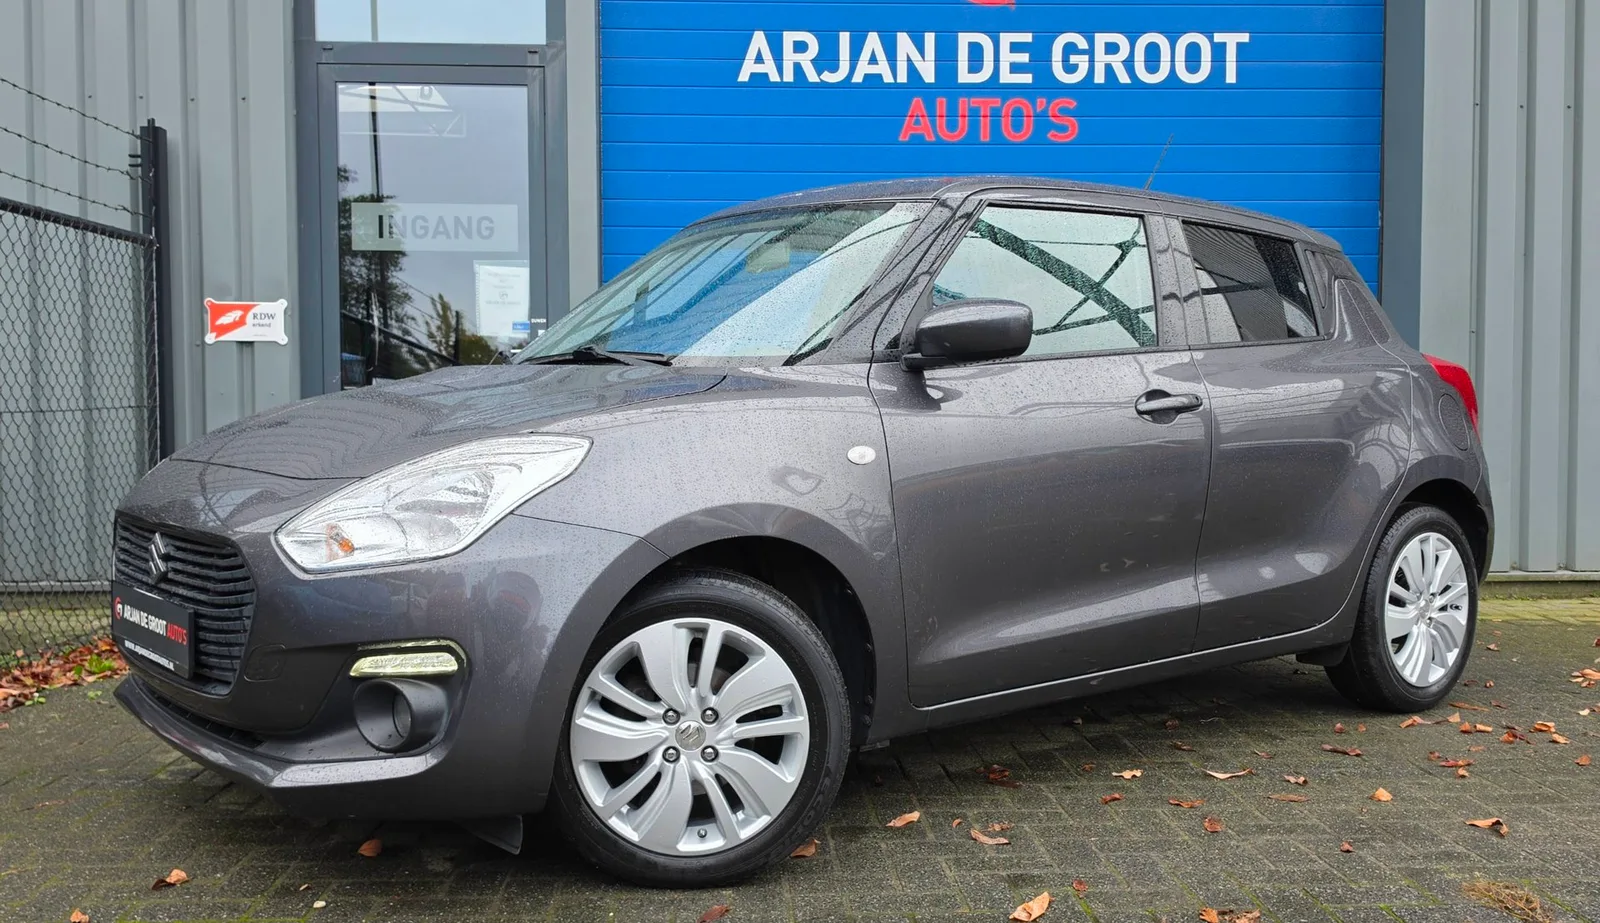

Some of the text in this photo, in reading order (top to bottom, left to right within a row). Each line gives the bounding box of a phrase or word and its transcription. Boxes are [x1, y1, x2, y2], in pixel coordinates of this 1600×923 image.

[737, 31, 1250, 84] ARJAN DE GROOT
[899, 98, 1079, 142] AUTO'S
[378, 214, 496, 240] INGANG
[252, 312, 276, 321] RDW
[123, 604, 141, 625] ARJAN
[140, 611, 149, 629] DE
[147, 615, 167, 637] GROOT
